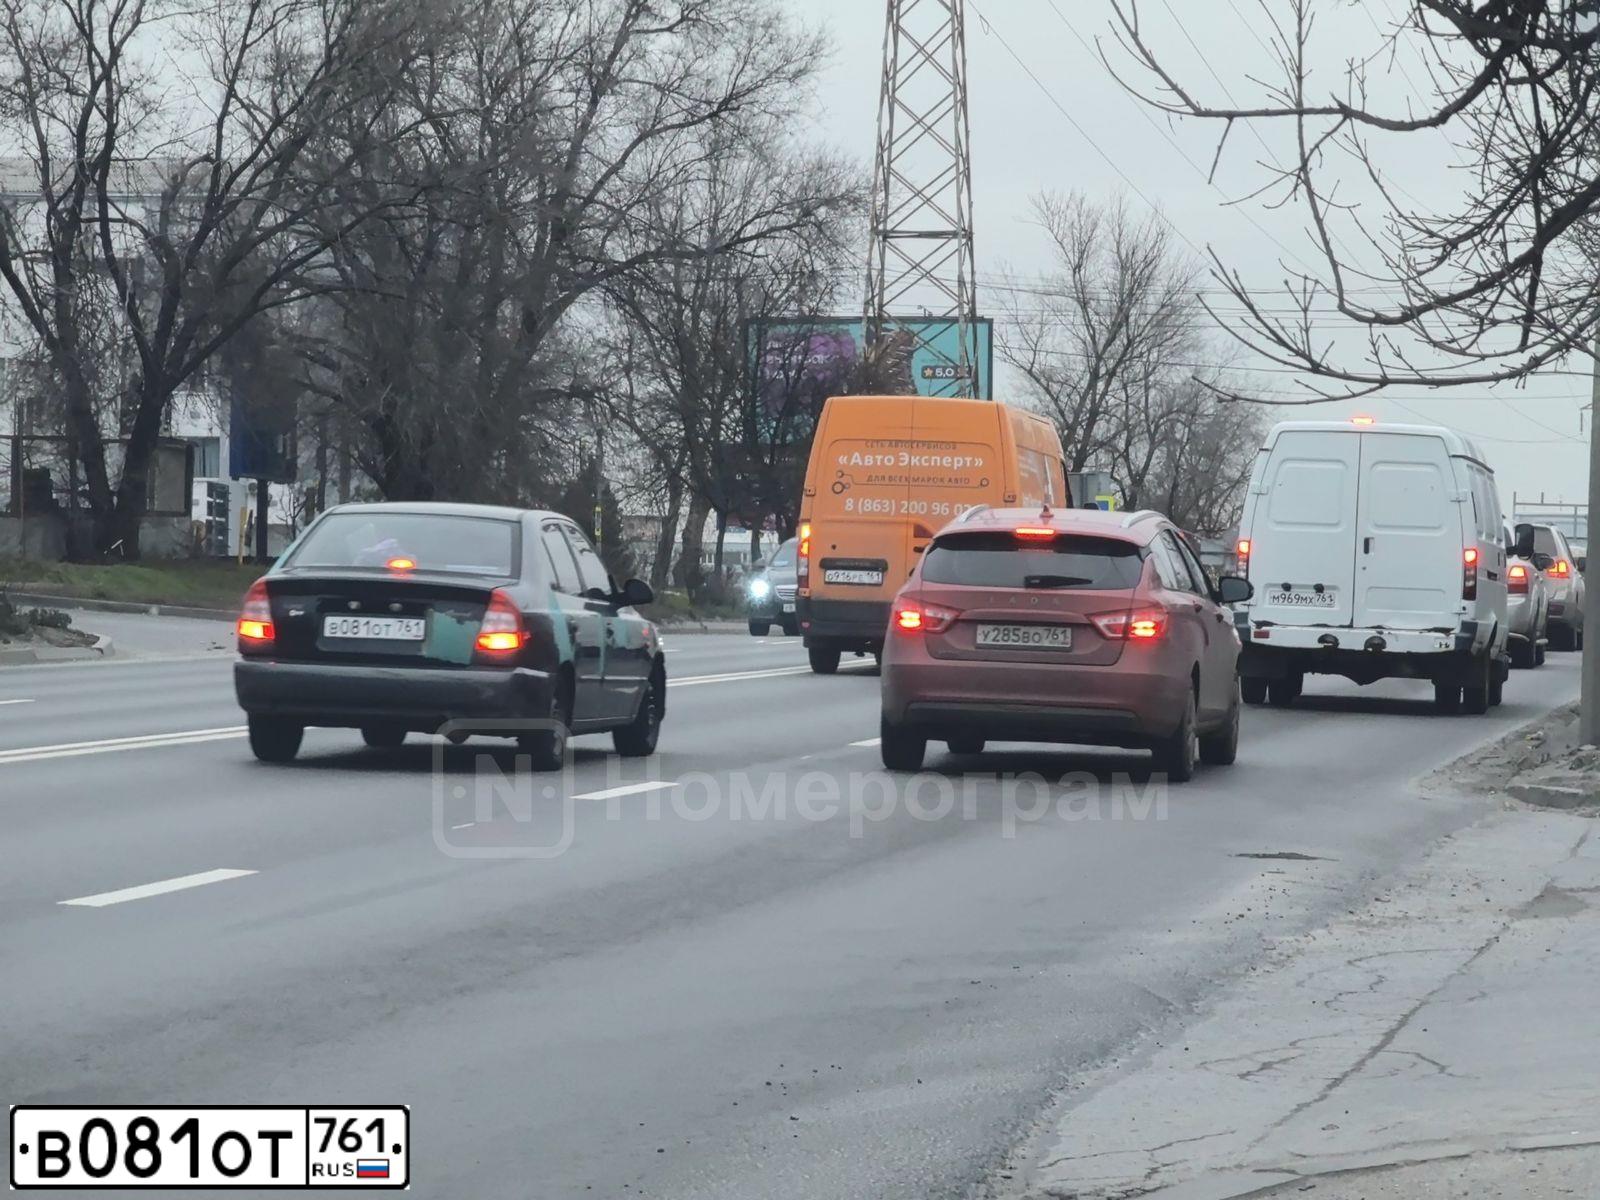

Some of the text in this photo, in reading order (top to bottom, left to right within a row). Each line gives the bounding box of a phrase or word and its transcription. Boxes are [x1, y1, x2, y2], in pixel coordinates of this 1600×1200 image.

[838, 452, 983, 469] «Авто Эксперт»
[867, 474, 970, 485] ДЛЯ ВСЕХ МАРОК АВТО
[844, 498, 854, 512] 8
[858, 498, 896, 516] (863)
[900, 500, 928, 514] 200
[931, 502, 949, 516] 96
[329, 619, 420, 636] В081ОТ 761
[982, 627, 1068, 644] У285ВО 761
